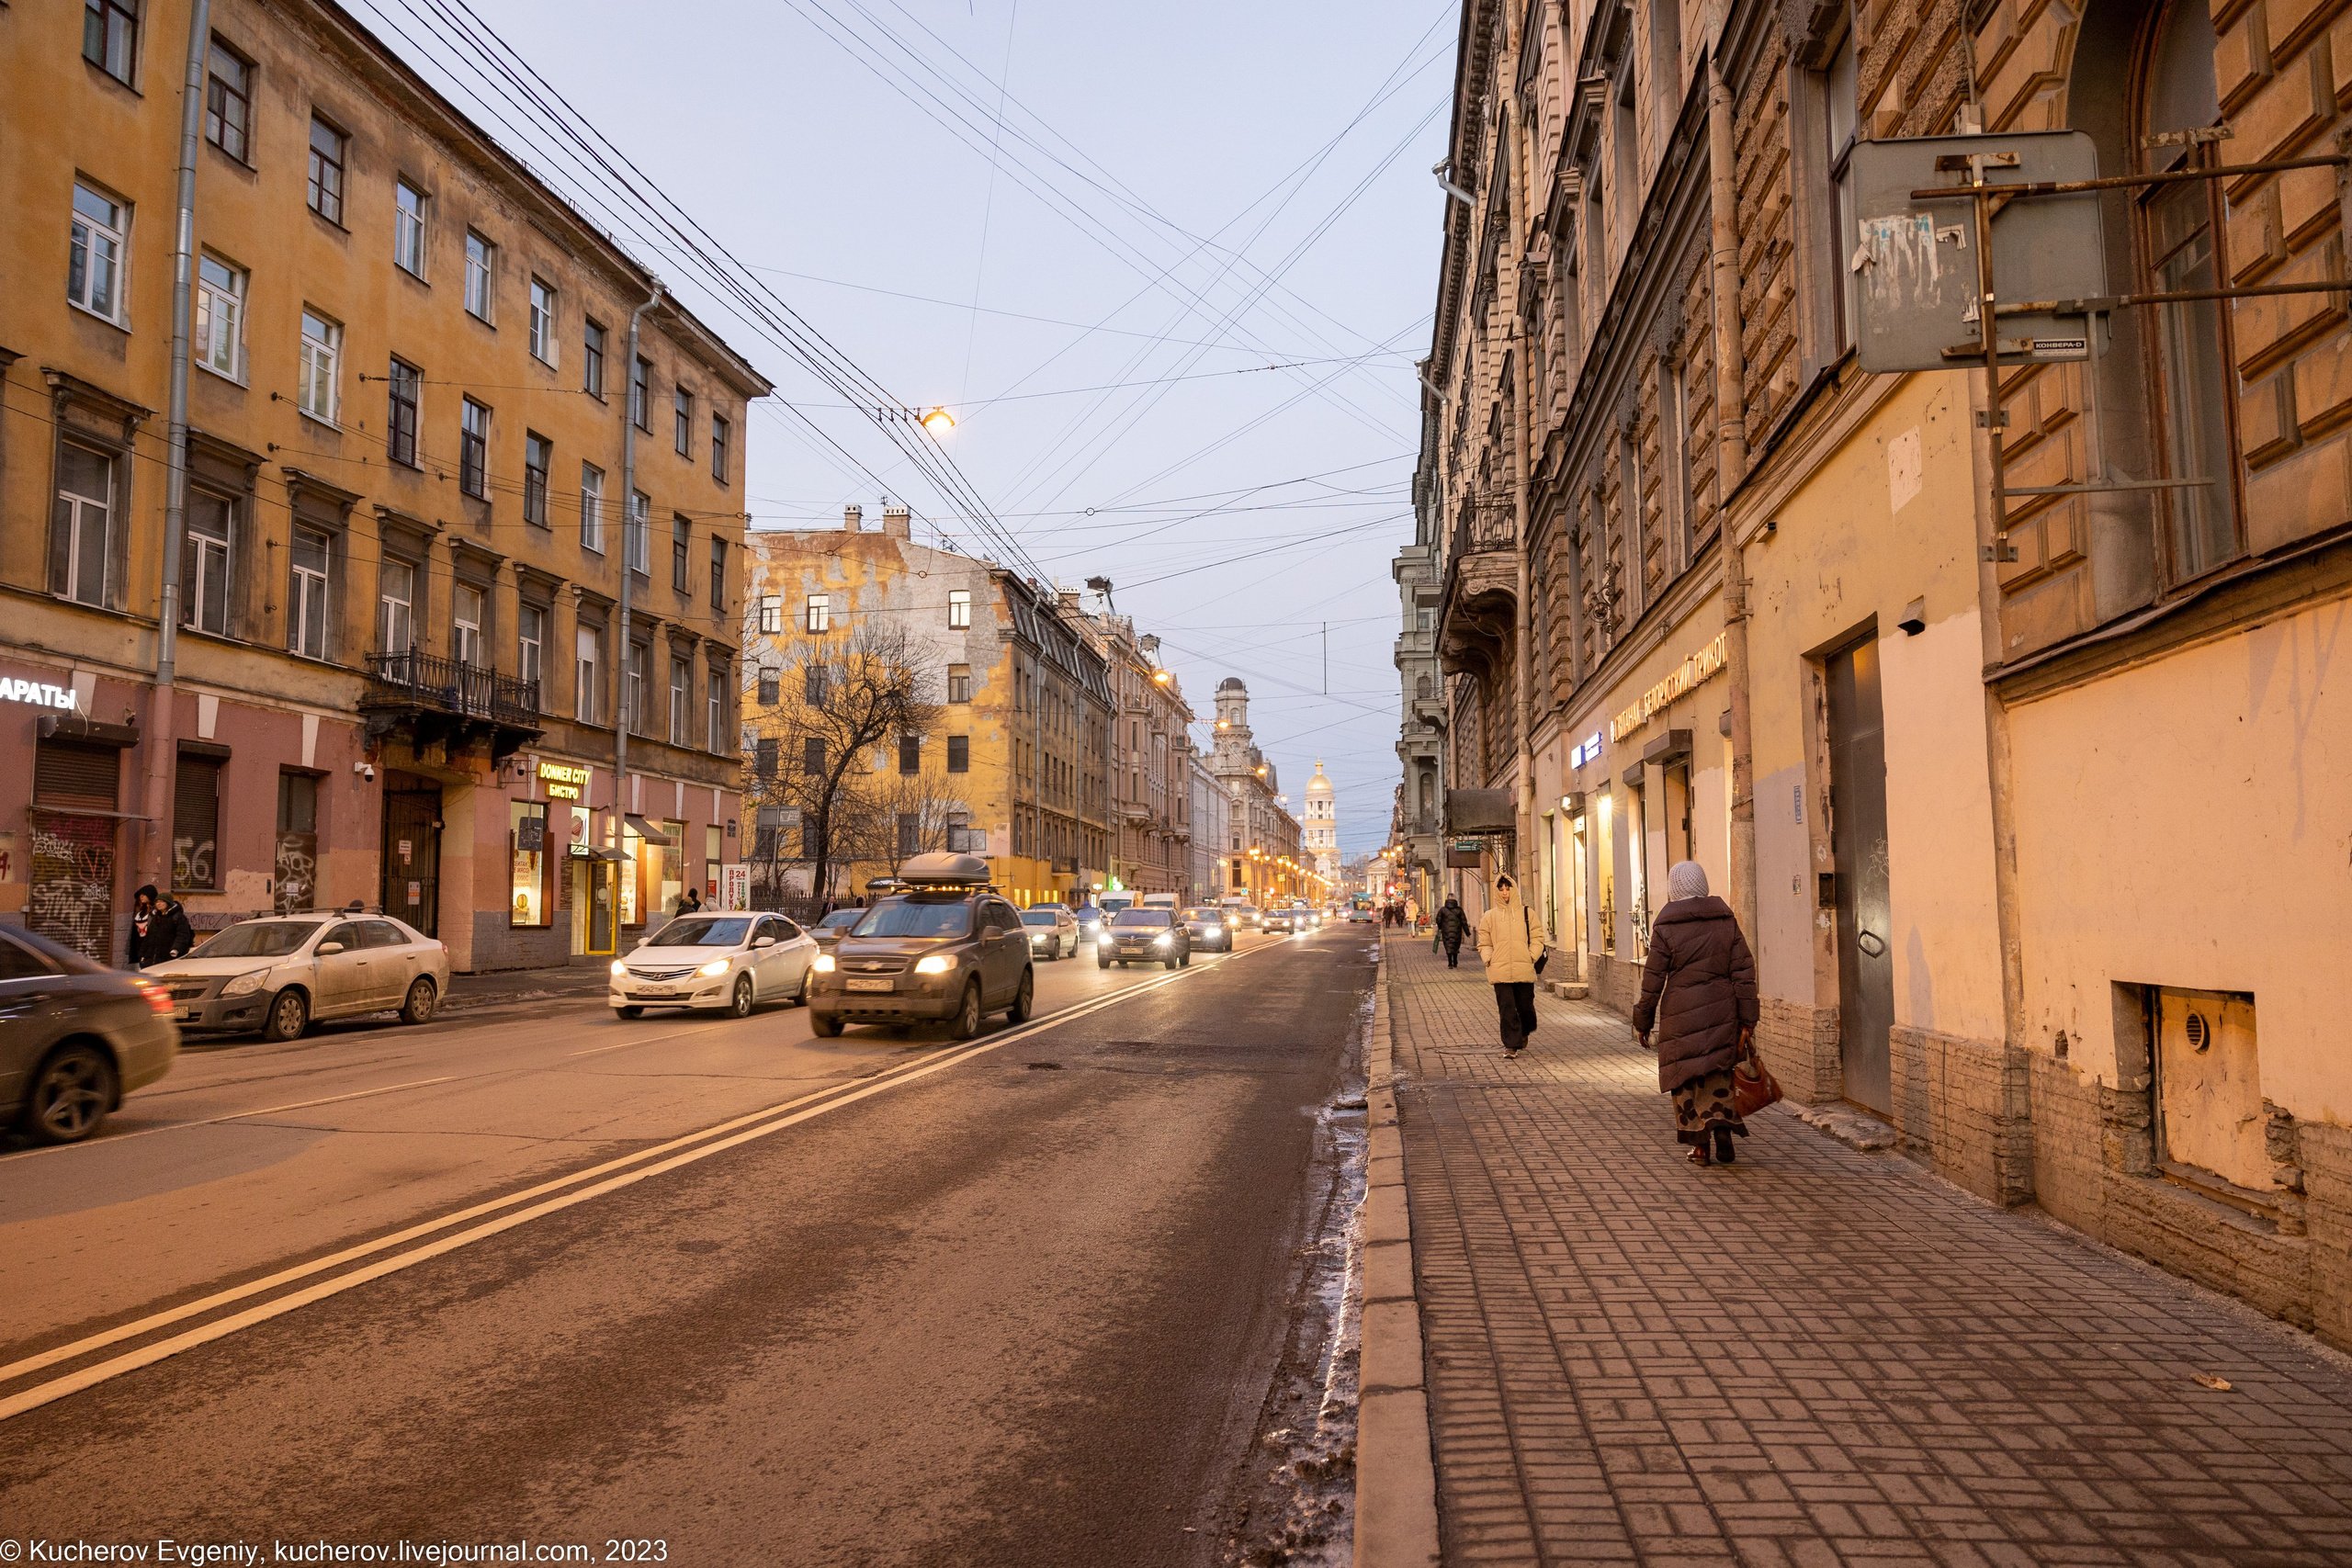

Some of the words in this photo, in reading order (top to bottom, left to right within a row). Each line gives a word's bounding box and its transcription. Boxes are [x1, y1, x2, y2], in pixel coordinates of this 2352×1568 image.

[1644, 653, 1690, 716] БЕЛОРУССКИЙ
[1693, 631, 1727, 682] ТРИКОТ
[0, 677, 76, 710] АРАТЫ
[540, 762, 572, 783] DONNER
[572, 768, 591, 785] CITY
[548, 783, 579, 800] БИСТРО
